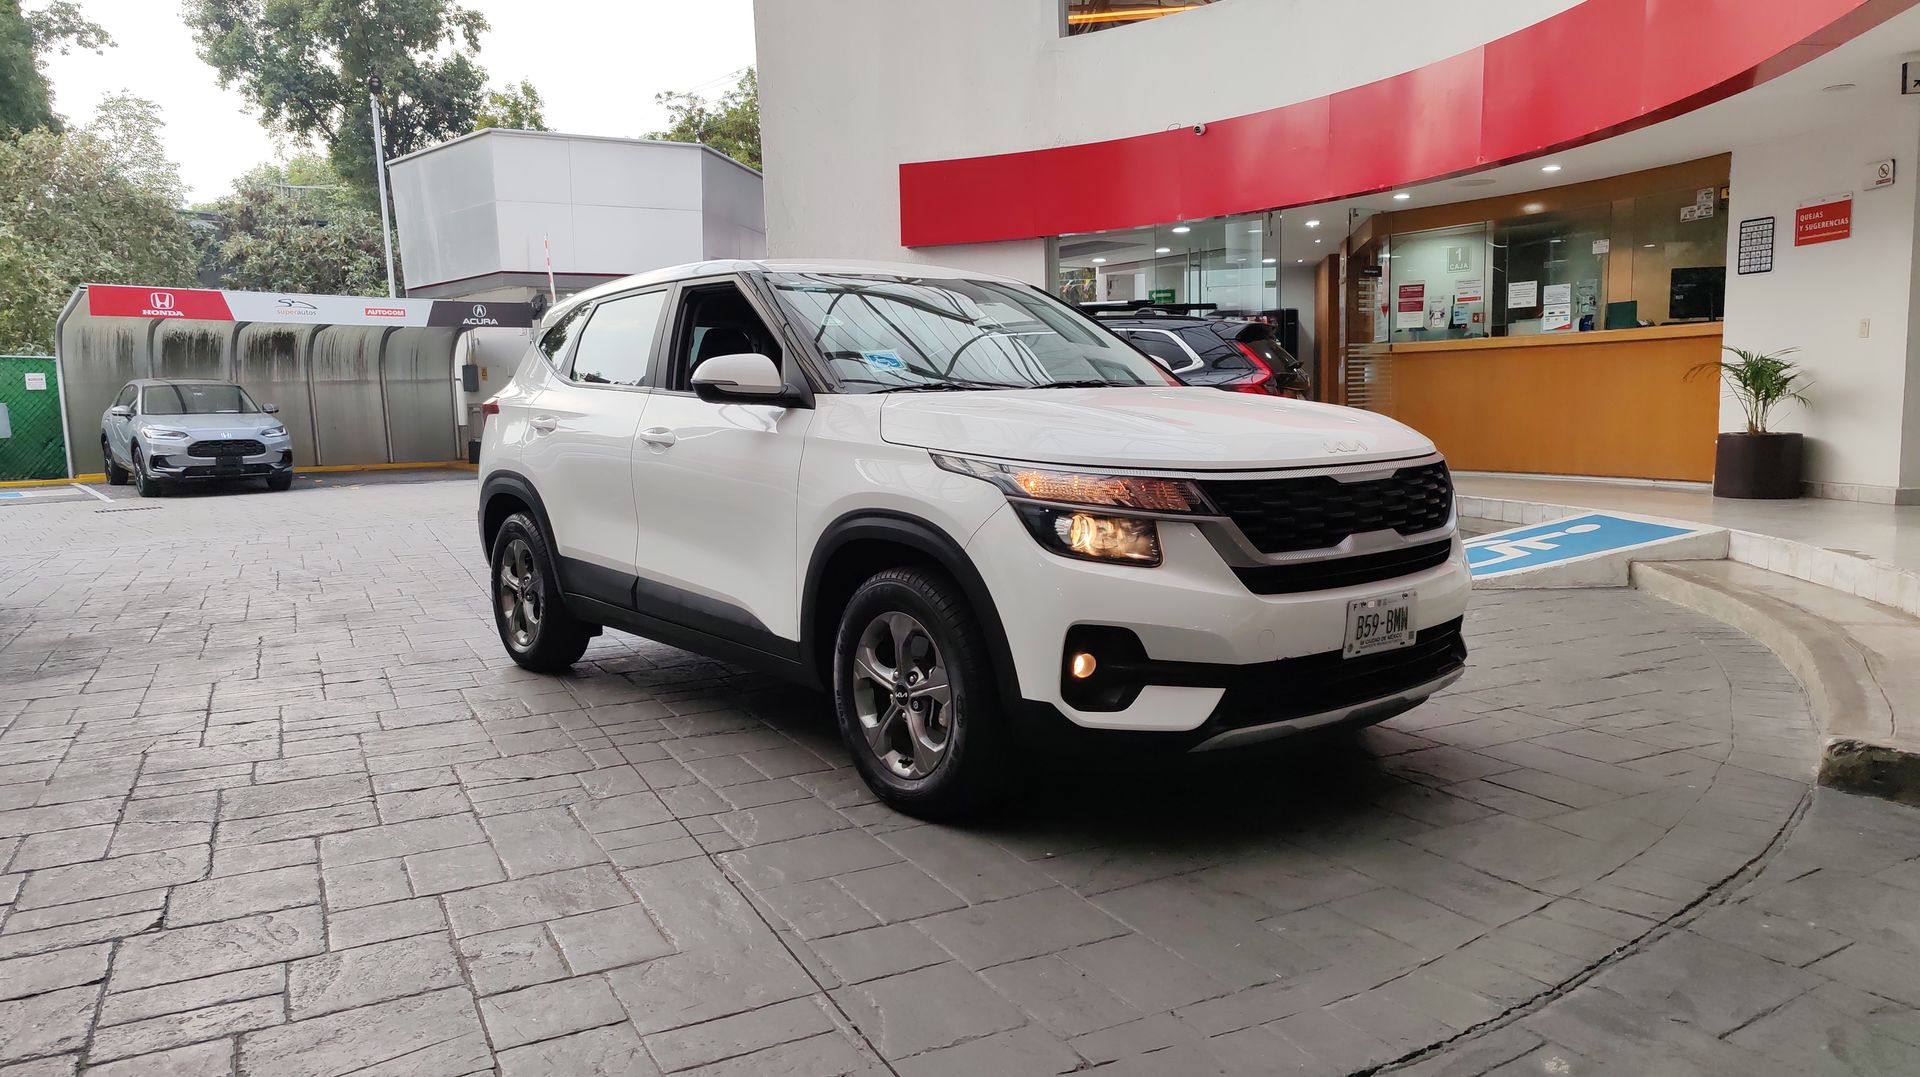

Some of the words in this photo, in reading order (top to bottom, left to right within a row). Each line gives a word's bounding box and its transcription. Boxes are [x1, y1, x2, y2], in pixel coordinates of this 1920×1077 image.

[1800, 211, 1824, 222] QUEJAS
[1805, 217, 1849, 231] SUGERENCIAS
[1455, 247, 1462, 261] 1
[142, 309, 184, 317] HONDA
[276, 308, 317, 317] superautos
